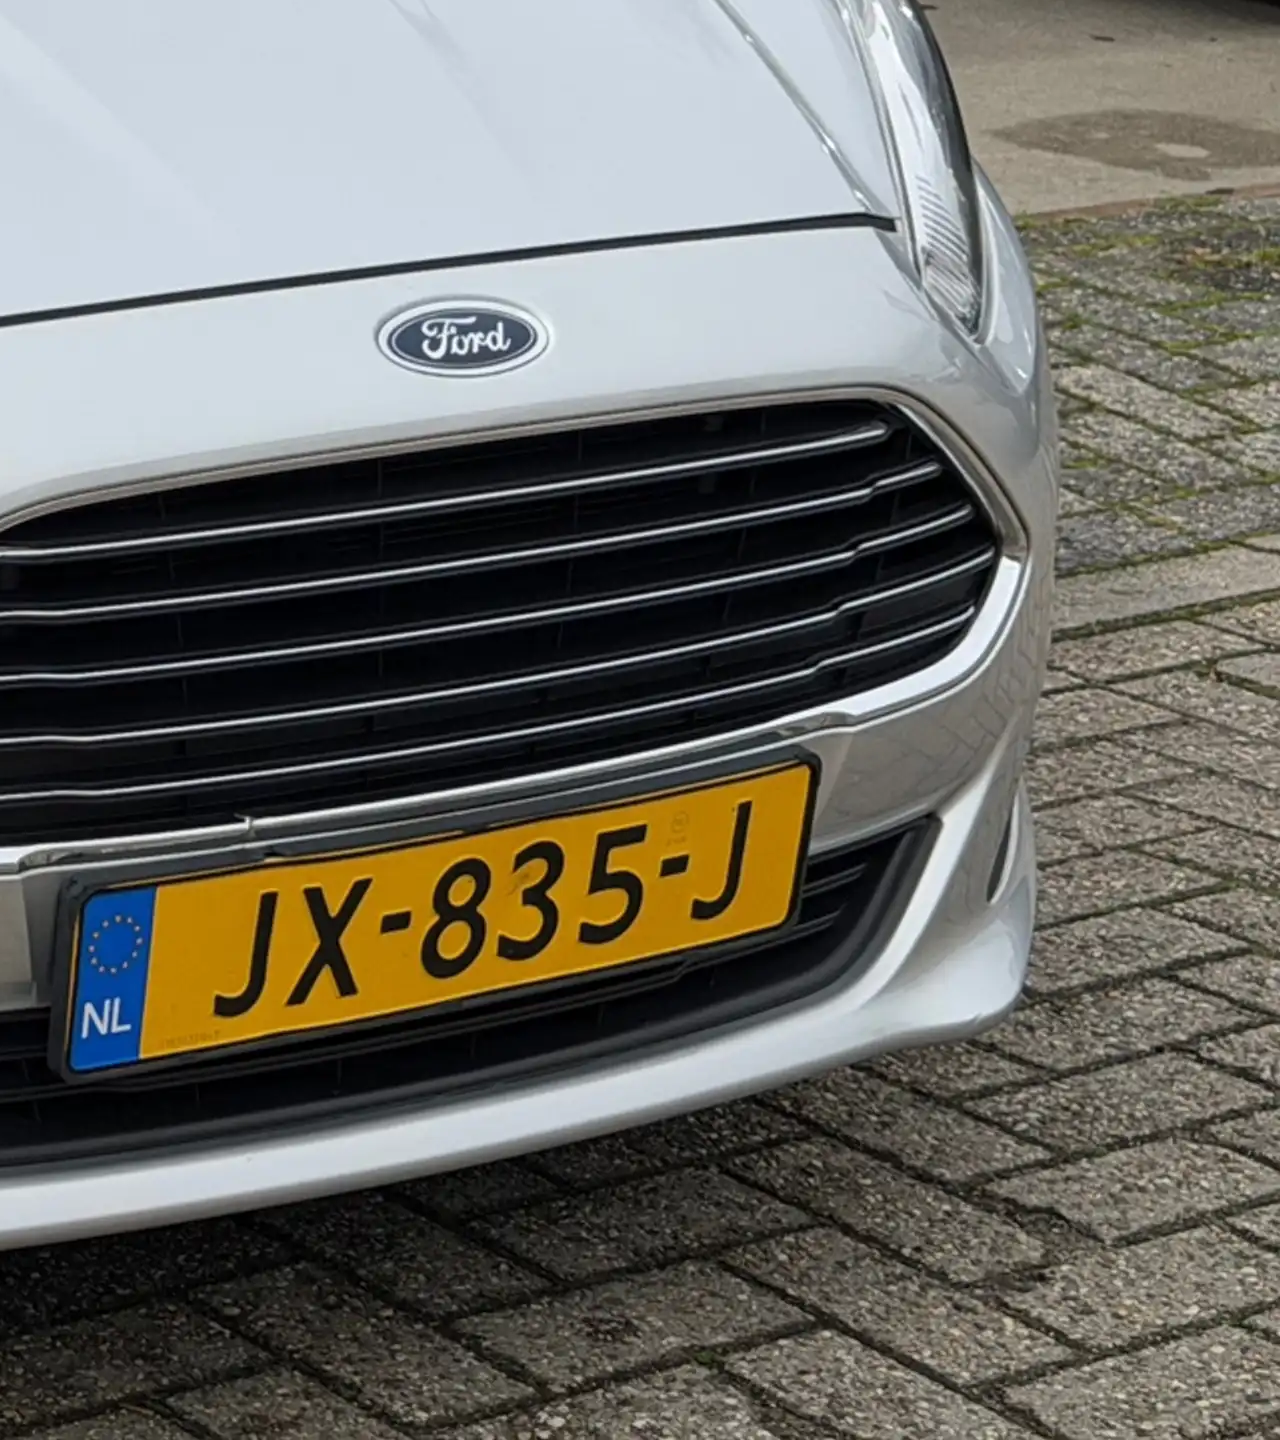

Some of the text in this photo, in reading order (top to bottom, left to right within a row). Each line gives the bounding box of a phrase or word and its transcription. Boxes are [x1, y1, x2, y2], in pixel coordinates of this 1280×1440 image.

[421, 316, 511, 359] Ford
[212, 800, 753, 1018] JX-835-J
[81, 996, 132, 1039] NL
